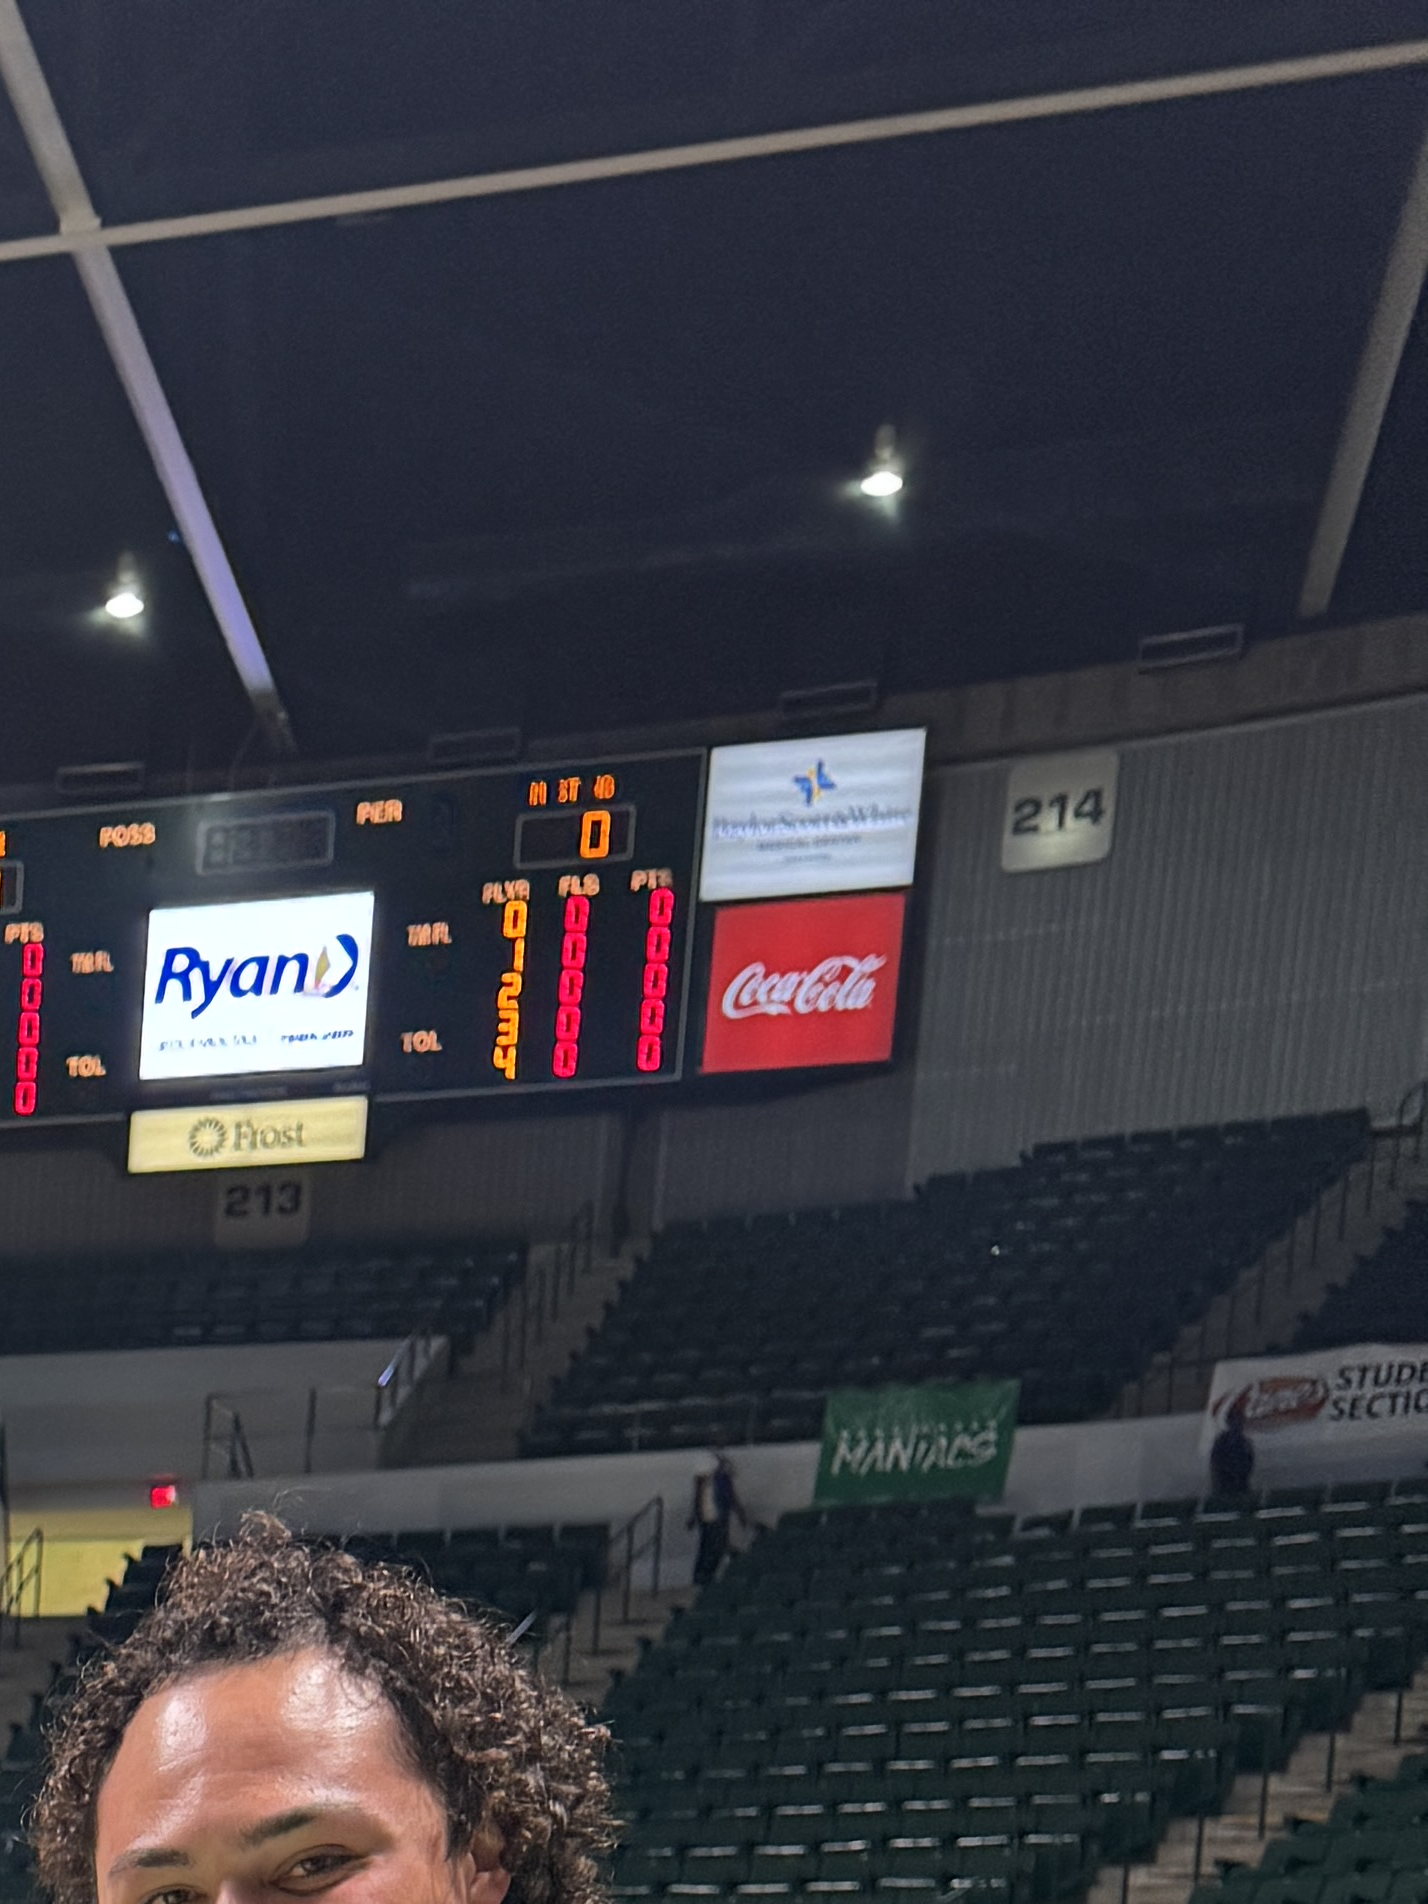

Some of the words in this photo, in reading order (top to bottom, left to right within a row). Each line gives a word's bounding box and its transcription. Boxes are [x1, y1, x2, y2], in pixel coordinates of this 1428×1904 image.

[1012, 786, 1106, 836] 214
[579, 809, 611, 859] 0
[503, 900, 528, 938] 0
[564, 895, 590, 932] 0
[650, 887, 675, 926] 0
[22, 943, 44, 977] 0
[513, 937, 524, 973] 1
[561, 932, 587, 969] 0
[647, 926, 671, 963] 0
[21, 978, 42, 1012] 0
[154, 945, 310, 1019] Ryan
[497, 972, 522, 1010] 2
[559, 969, 584, 1006] 0
[644, 963, 668, 999] 0
[721, 953, 887, 1020] Coca-Cola
[18, 1012, 40, 1047] 0
[401, 1029, 442, 1053] TOL
[498, 1010, 519, 1046] 3
[556, 1006, 581, 1041] 0
[641, 999, 665, 1035] 0
[16, 1047, 38, 1082] 0
[493, 1046, 516, 1080] 4
[552, 1041, 578, 1078] 0
[637, 1035, 661, 1072] 0
[14, 1081, 36, 1116] 0
[232, 1120, 305, 1153] Frost
[224, 1179, 304, 1219] 213
